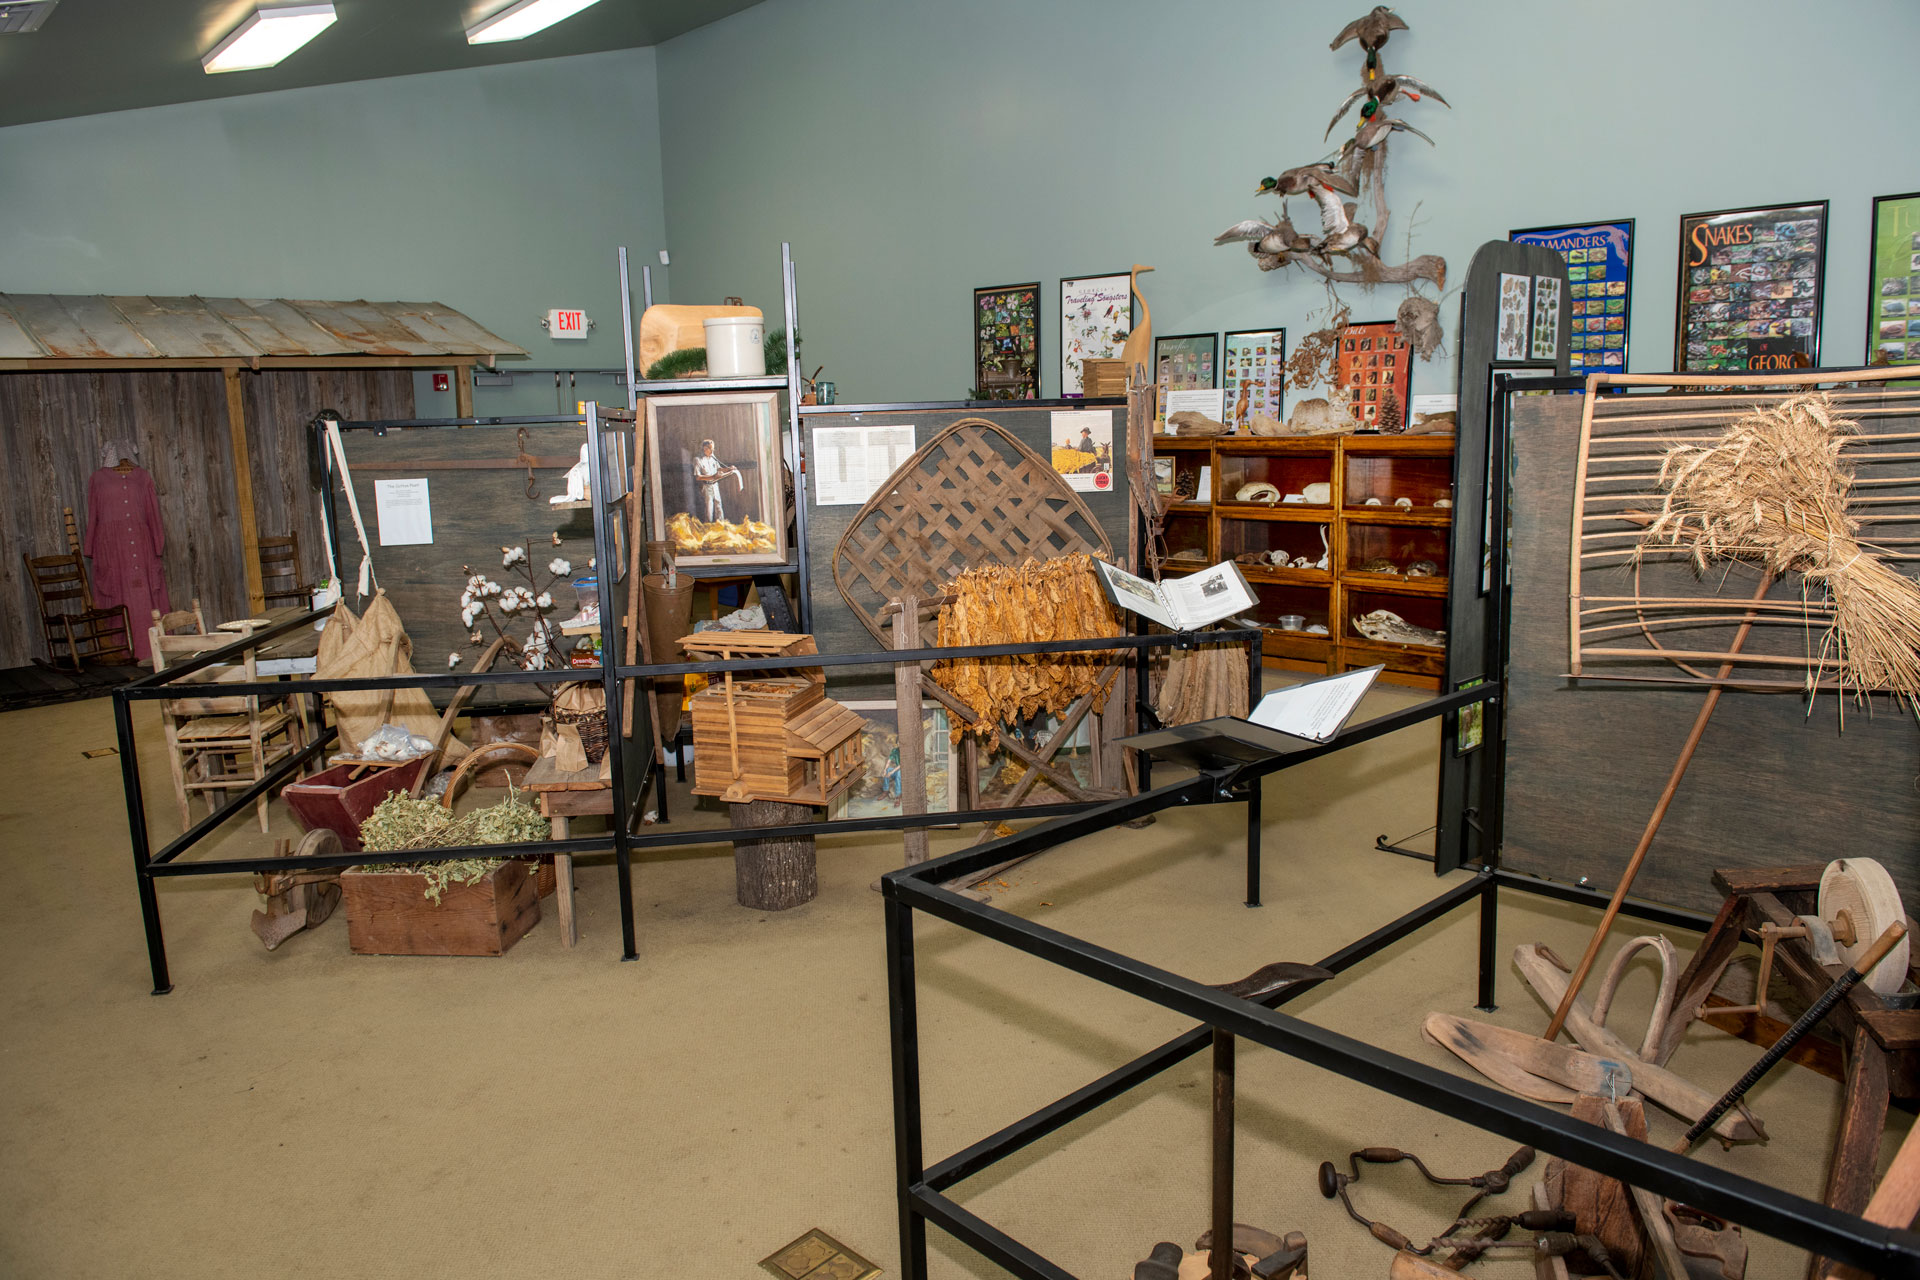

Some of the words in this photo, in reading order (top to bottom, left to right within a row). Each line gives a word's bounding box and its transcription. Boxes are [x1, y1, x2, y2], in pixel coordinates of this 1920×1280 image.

[1518, 234, 1606, 250] AMANDERS
[1689, 223, 1753, 267] SNAKES
[1065, 294, 1095, 305] Traveling
[1097, 292, 1128, 304] Songsters
[558, 311, 582, 331] EXIT
[1749, 353, 1809, 370] GEORG
